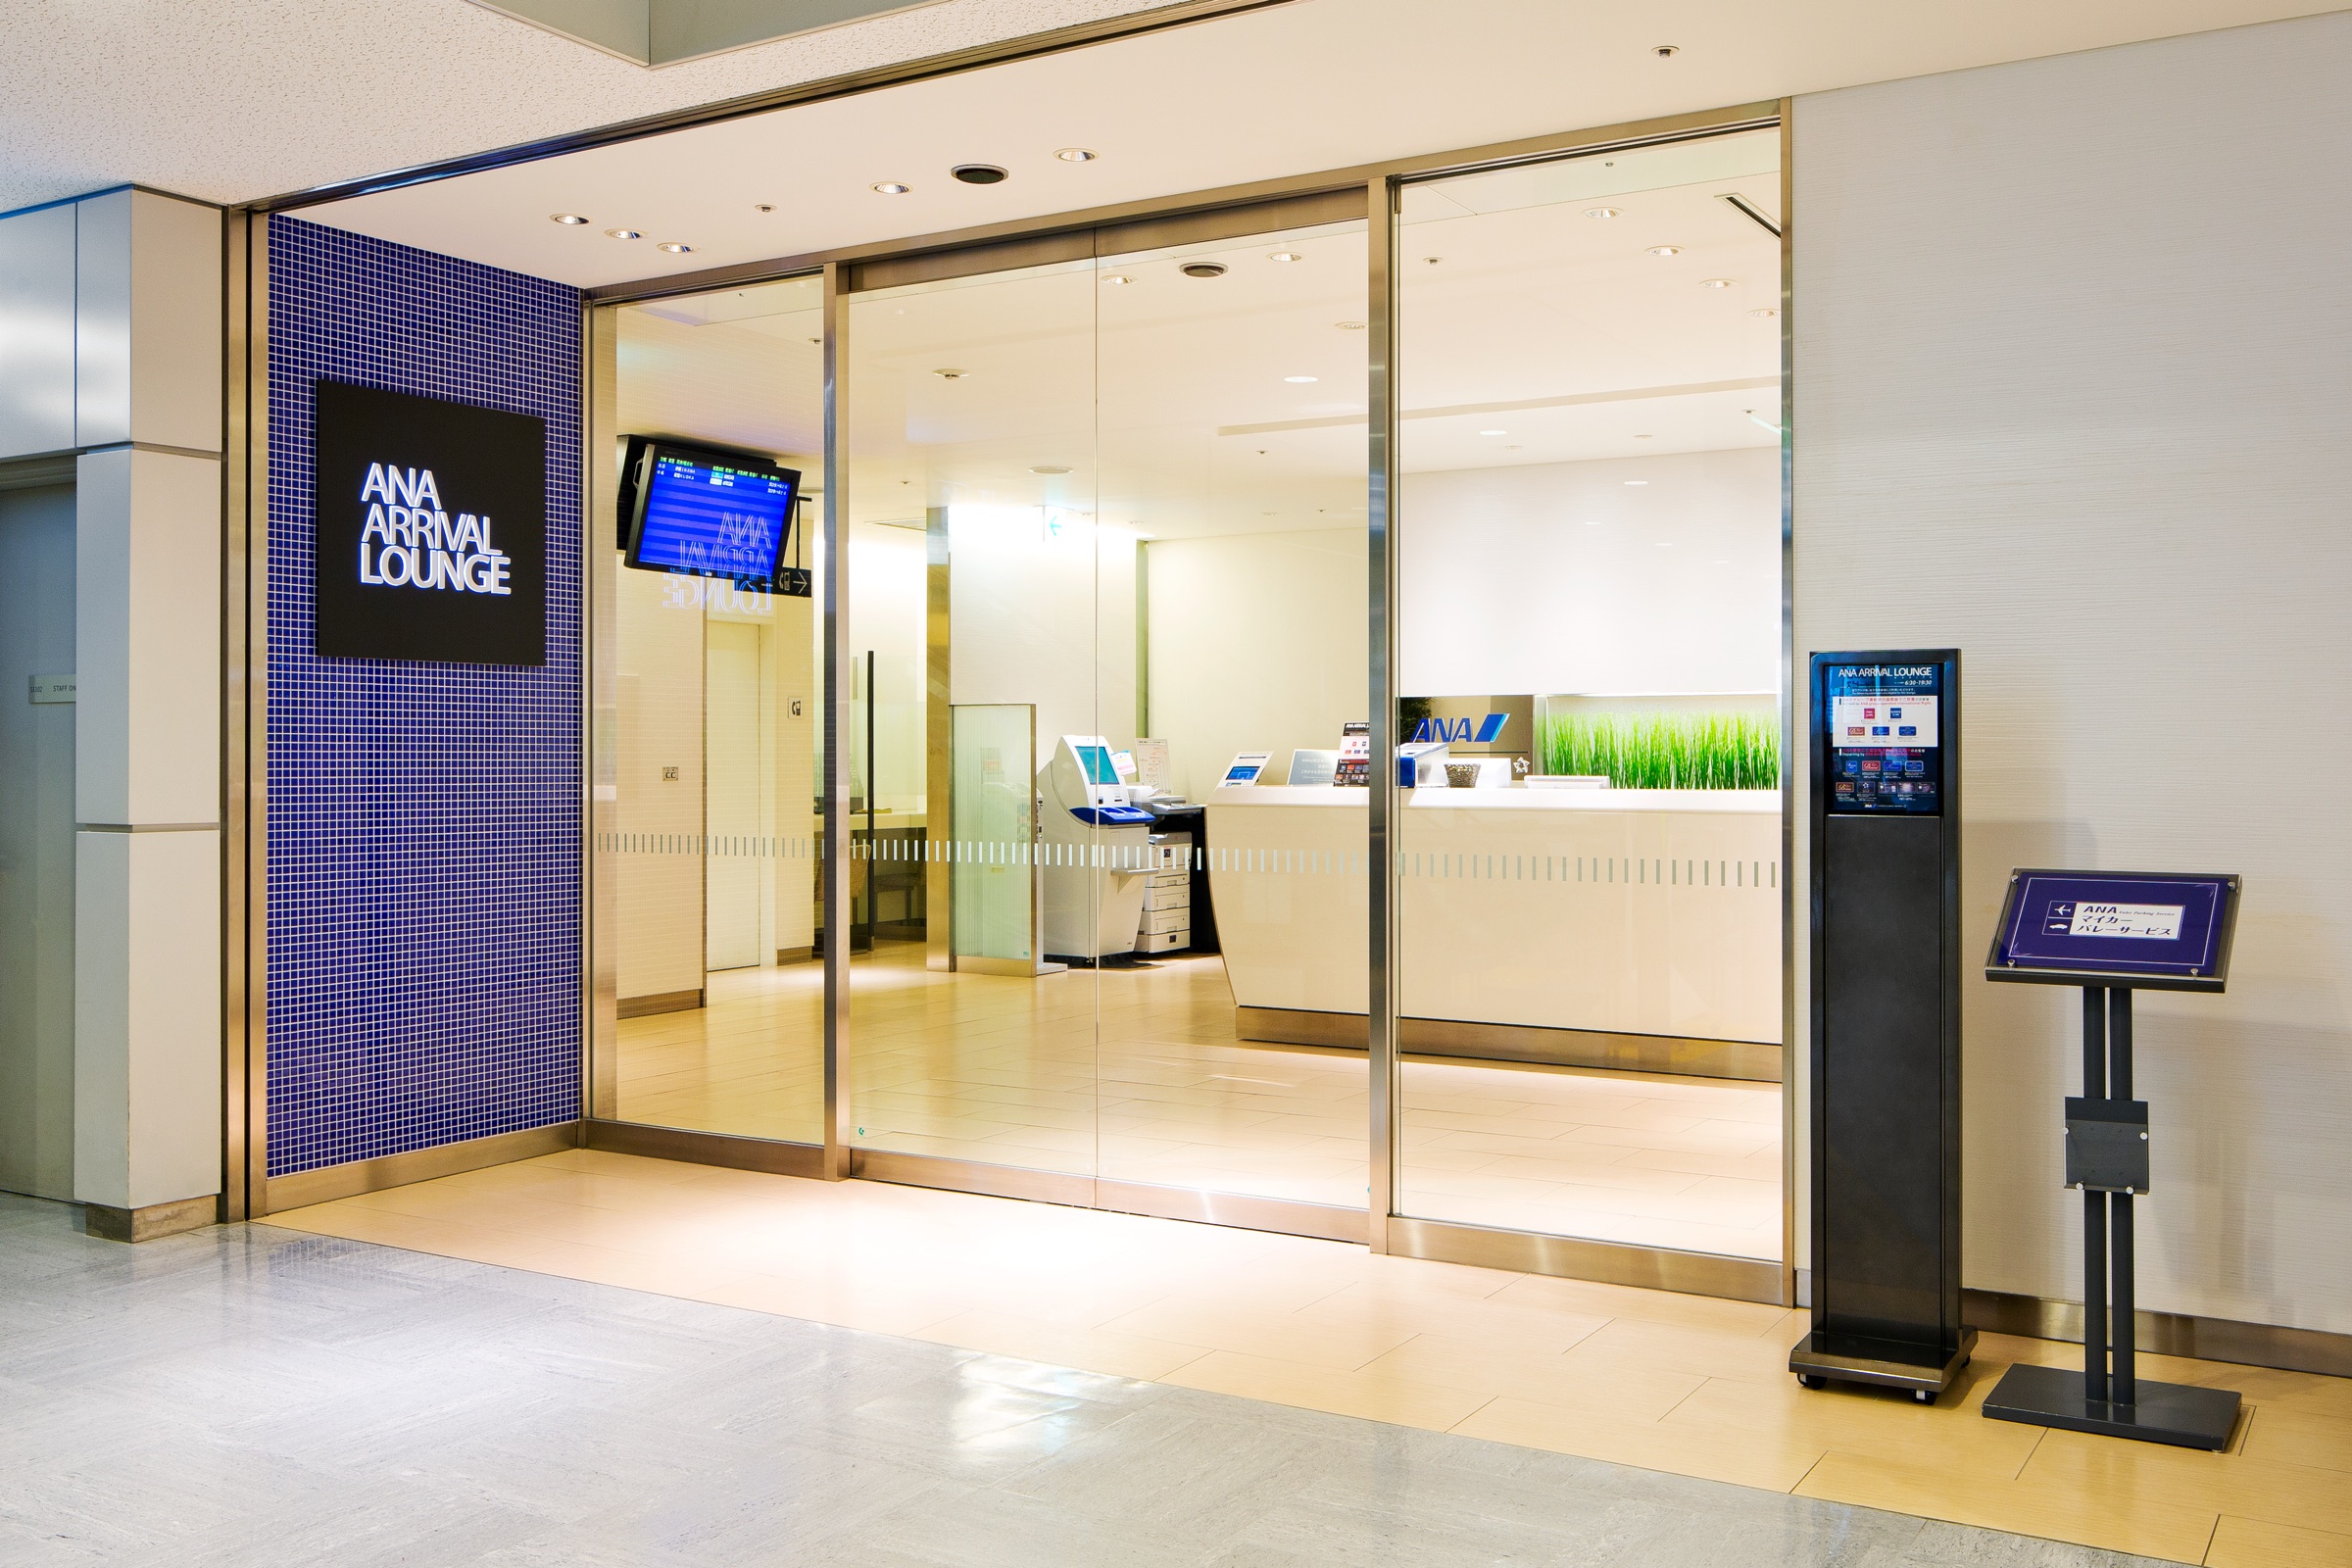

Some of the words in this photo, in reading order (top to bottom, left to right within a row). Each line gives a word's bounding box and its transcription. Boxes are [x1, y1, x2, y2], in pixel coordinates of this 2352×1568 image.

[361, 462, 442, 511] ANA
[361, 503, 503, 557] ARRIVAL
[361, 542, 512, 595] LOUNGE
[1838, 667, 1858, 677] ANA
[1858, 667, 1892, 677] ARRIVAL
[1893, 667, 1933, 676] LOUNGE
[1411, 717, 1473, 743] ANA
[2083, 906, 2117, 914] ANA
[2082, 915, 2133, 924] マイカー
[2077, 925, 2172, 936] バレーサービス
